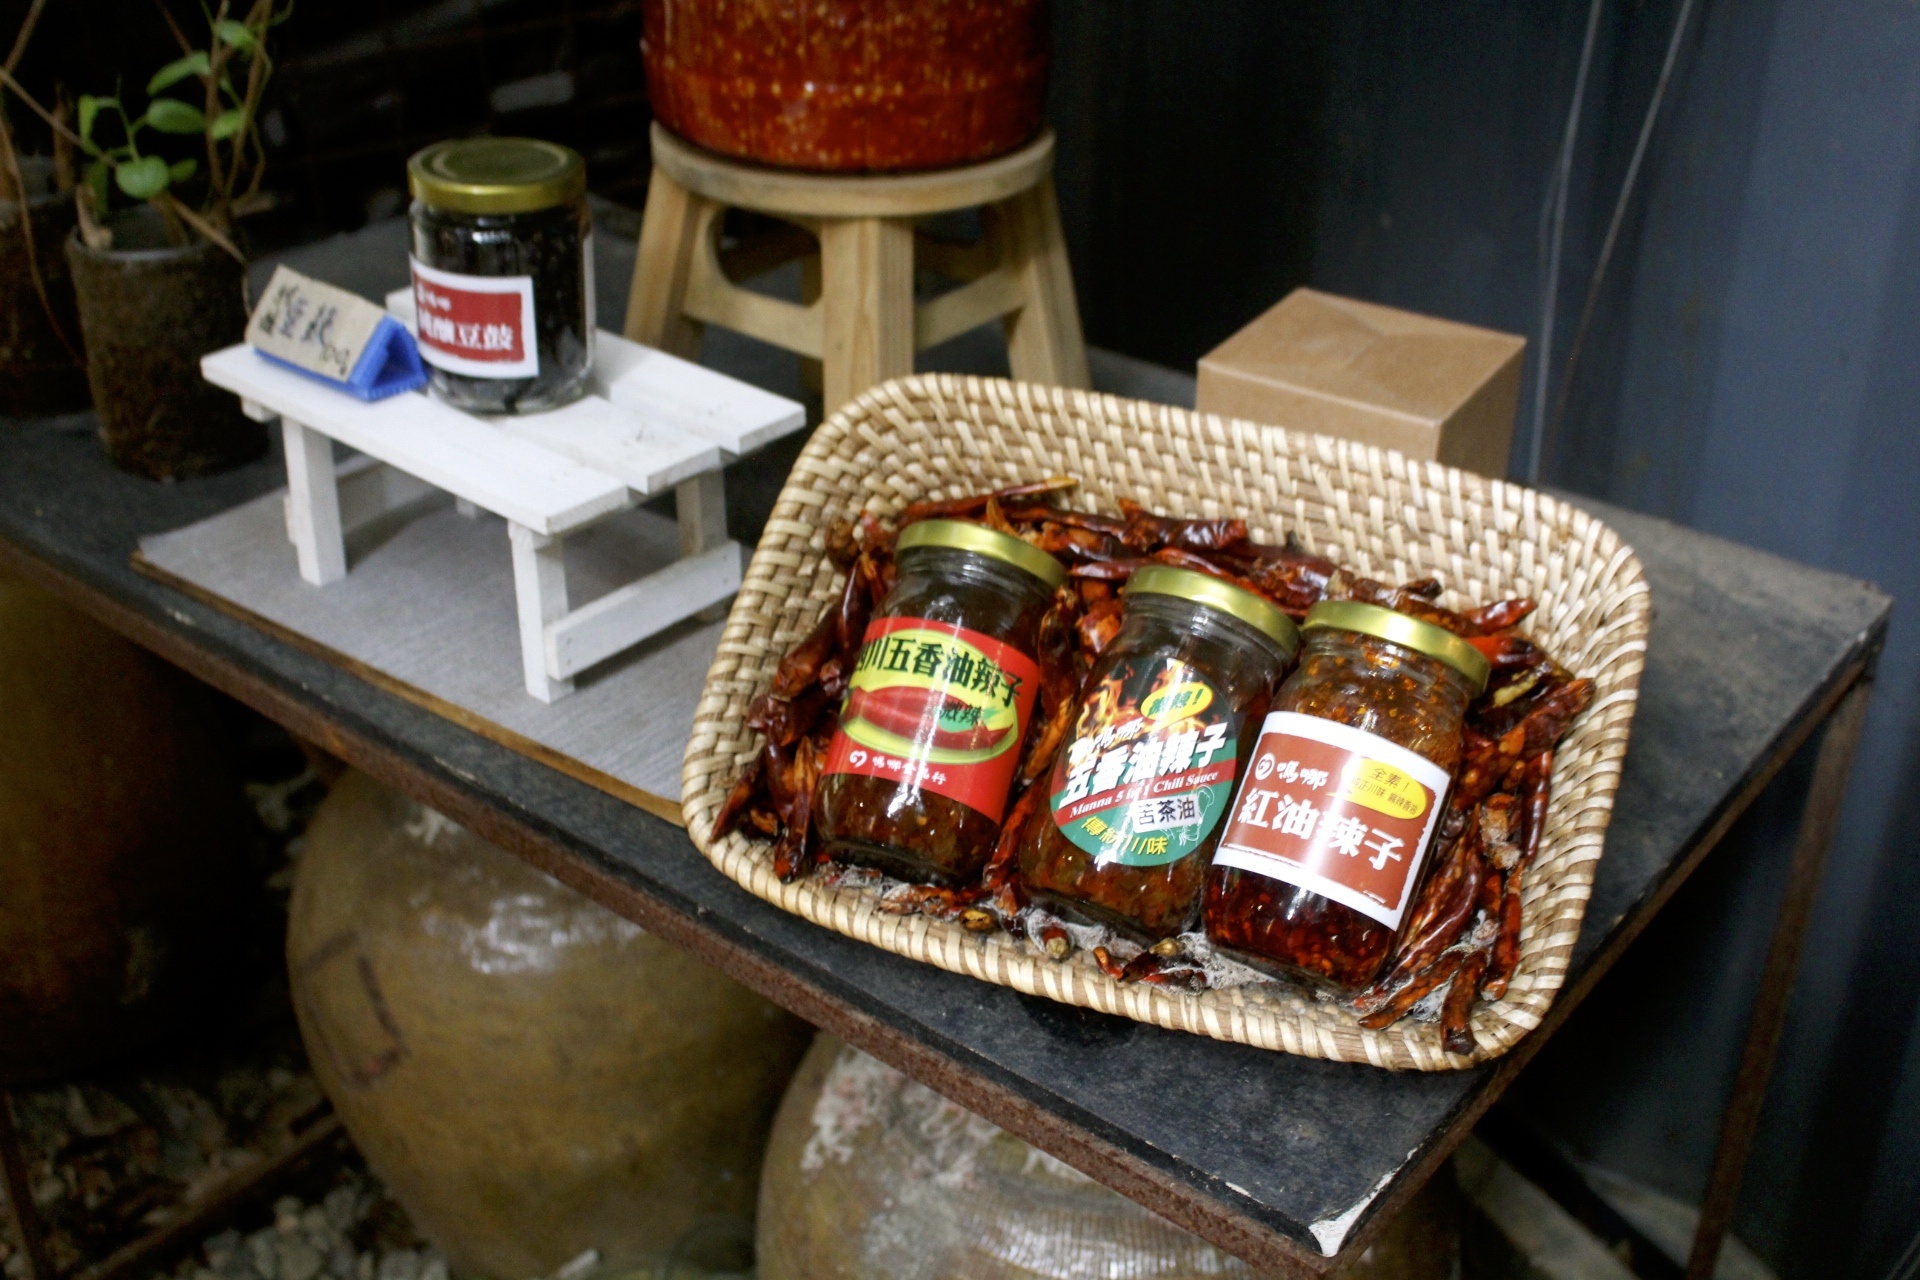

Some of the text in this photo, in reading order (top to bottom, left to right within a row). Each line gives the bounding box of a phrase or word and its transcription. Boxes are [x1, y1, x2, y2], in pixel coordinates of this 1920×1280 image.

[1059, 722, 1228, 809] 五香油辣子
[1277, 760, 1329, 791] 嗎哪
[1070, 796, 1112, 818] Manna
[1115, 791, 1125, 803] 5
[1153, 775, 1184, 794] Chili
[1187, 771, 1218, 786] Sauce
[1138, 797, 1196, 826] 苦茶油
[1237, 787, 1405, 871] 紅油辣子
